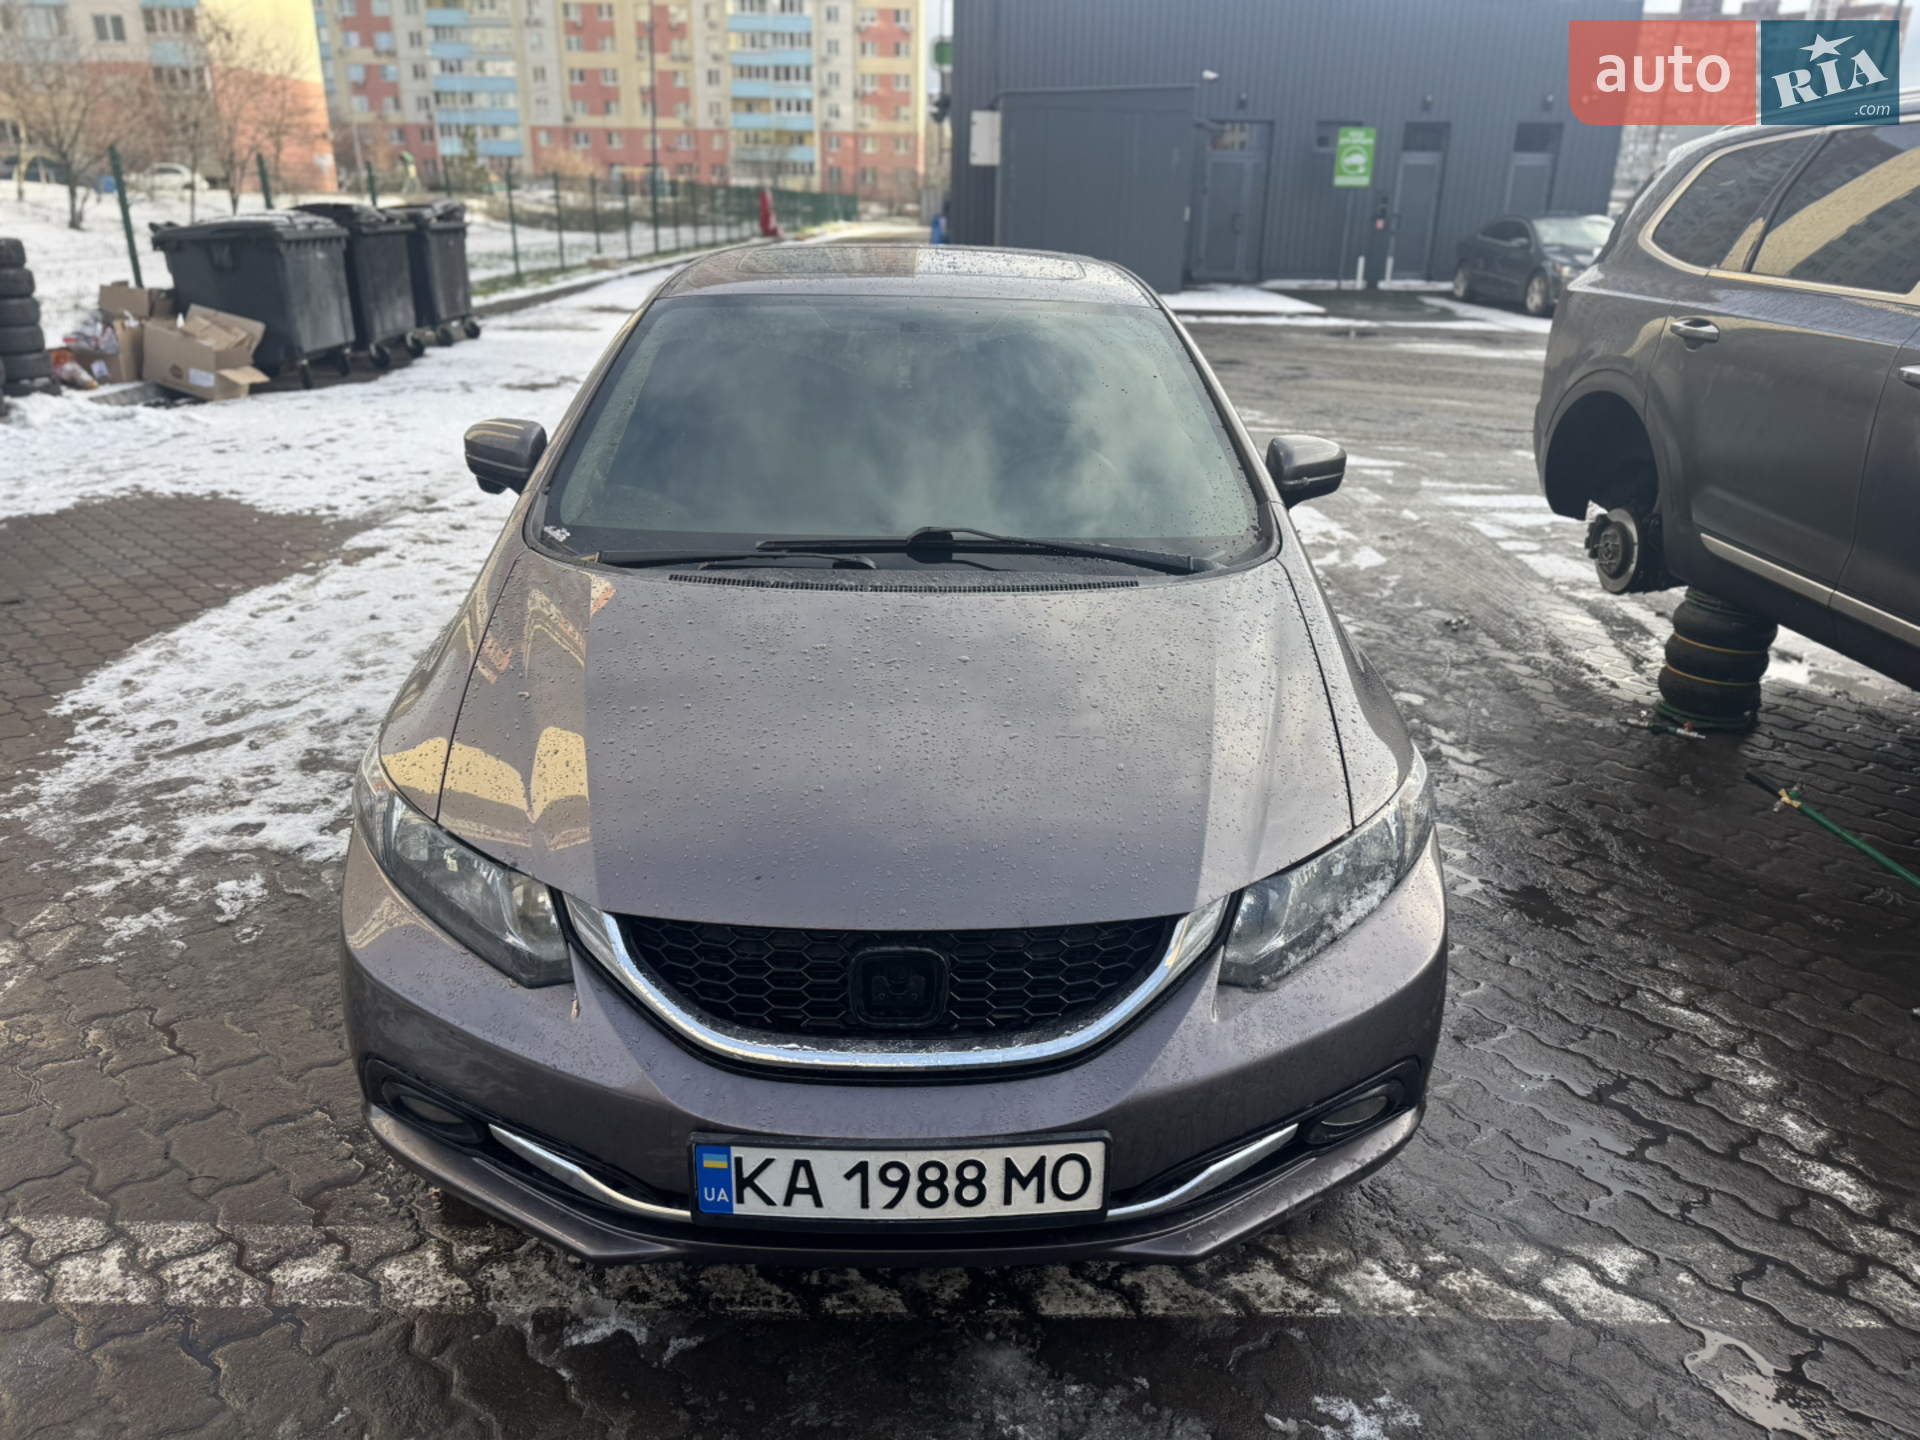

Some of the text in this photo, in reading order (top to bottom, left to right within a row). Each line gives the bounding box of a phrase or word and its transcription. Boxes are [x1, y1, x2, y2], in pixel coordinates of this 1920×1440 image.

[704, 1187, 730, 1203] UA
[734, 1153, 1092, 1209] KA 1988 MO
